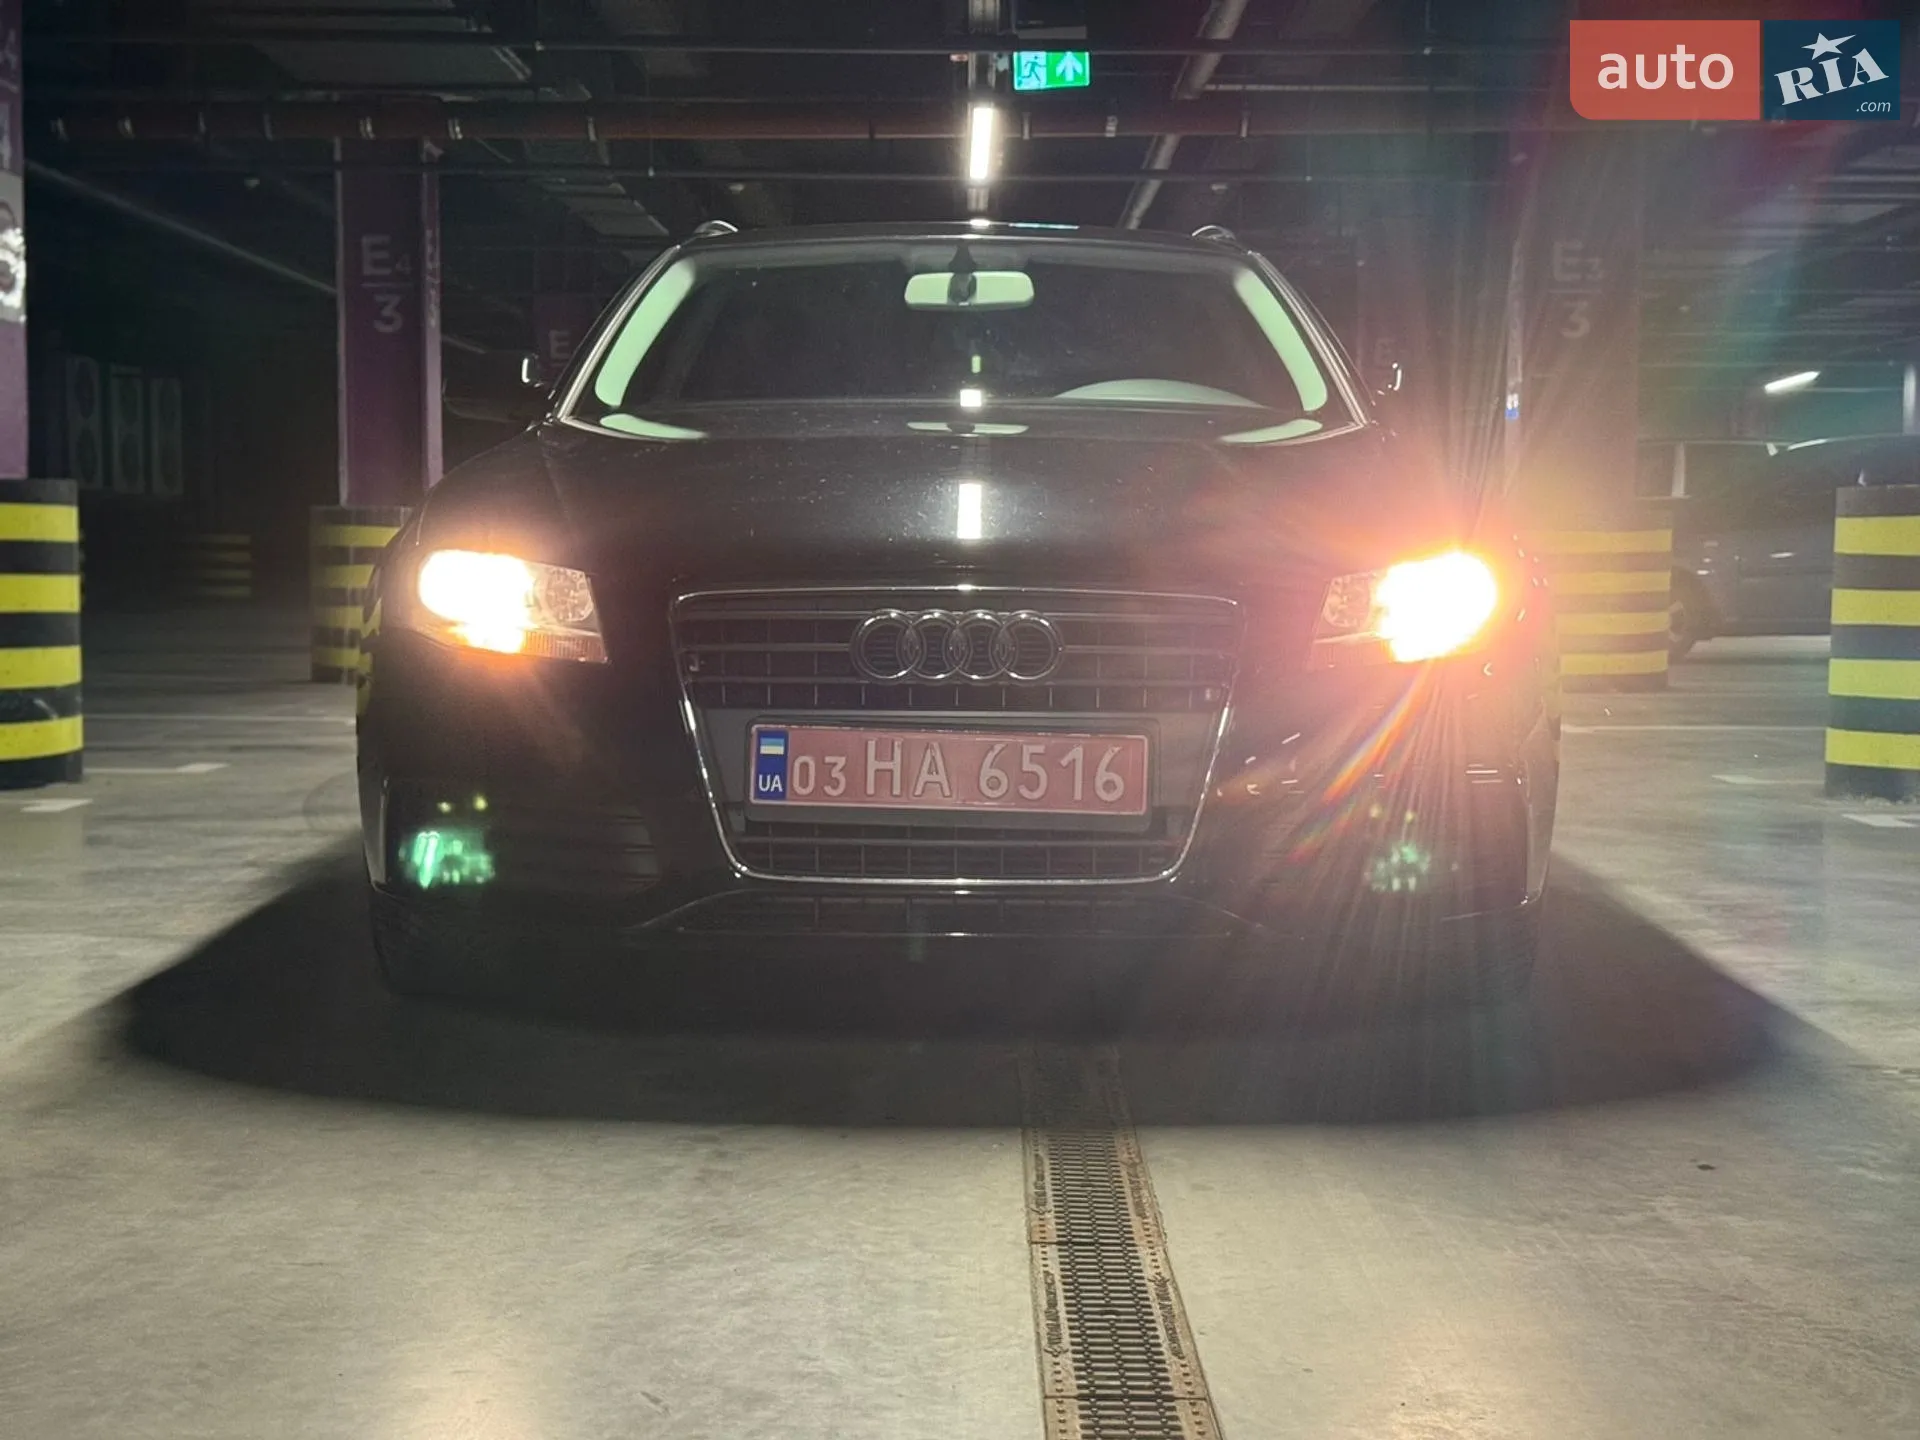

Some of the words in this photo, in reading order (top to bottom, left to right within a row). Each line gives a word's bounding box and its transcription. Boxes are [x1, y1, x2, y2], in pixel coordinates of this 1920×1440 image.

[373, 295, 403, 333] 3
[758, 774, 783, 793] UA
[792, 755, 847, 797] 03
[865, 739, 952, 798] HA
[977, 743, 1125, 803] 6516
